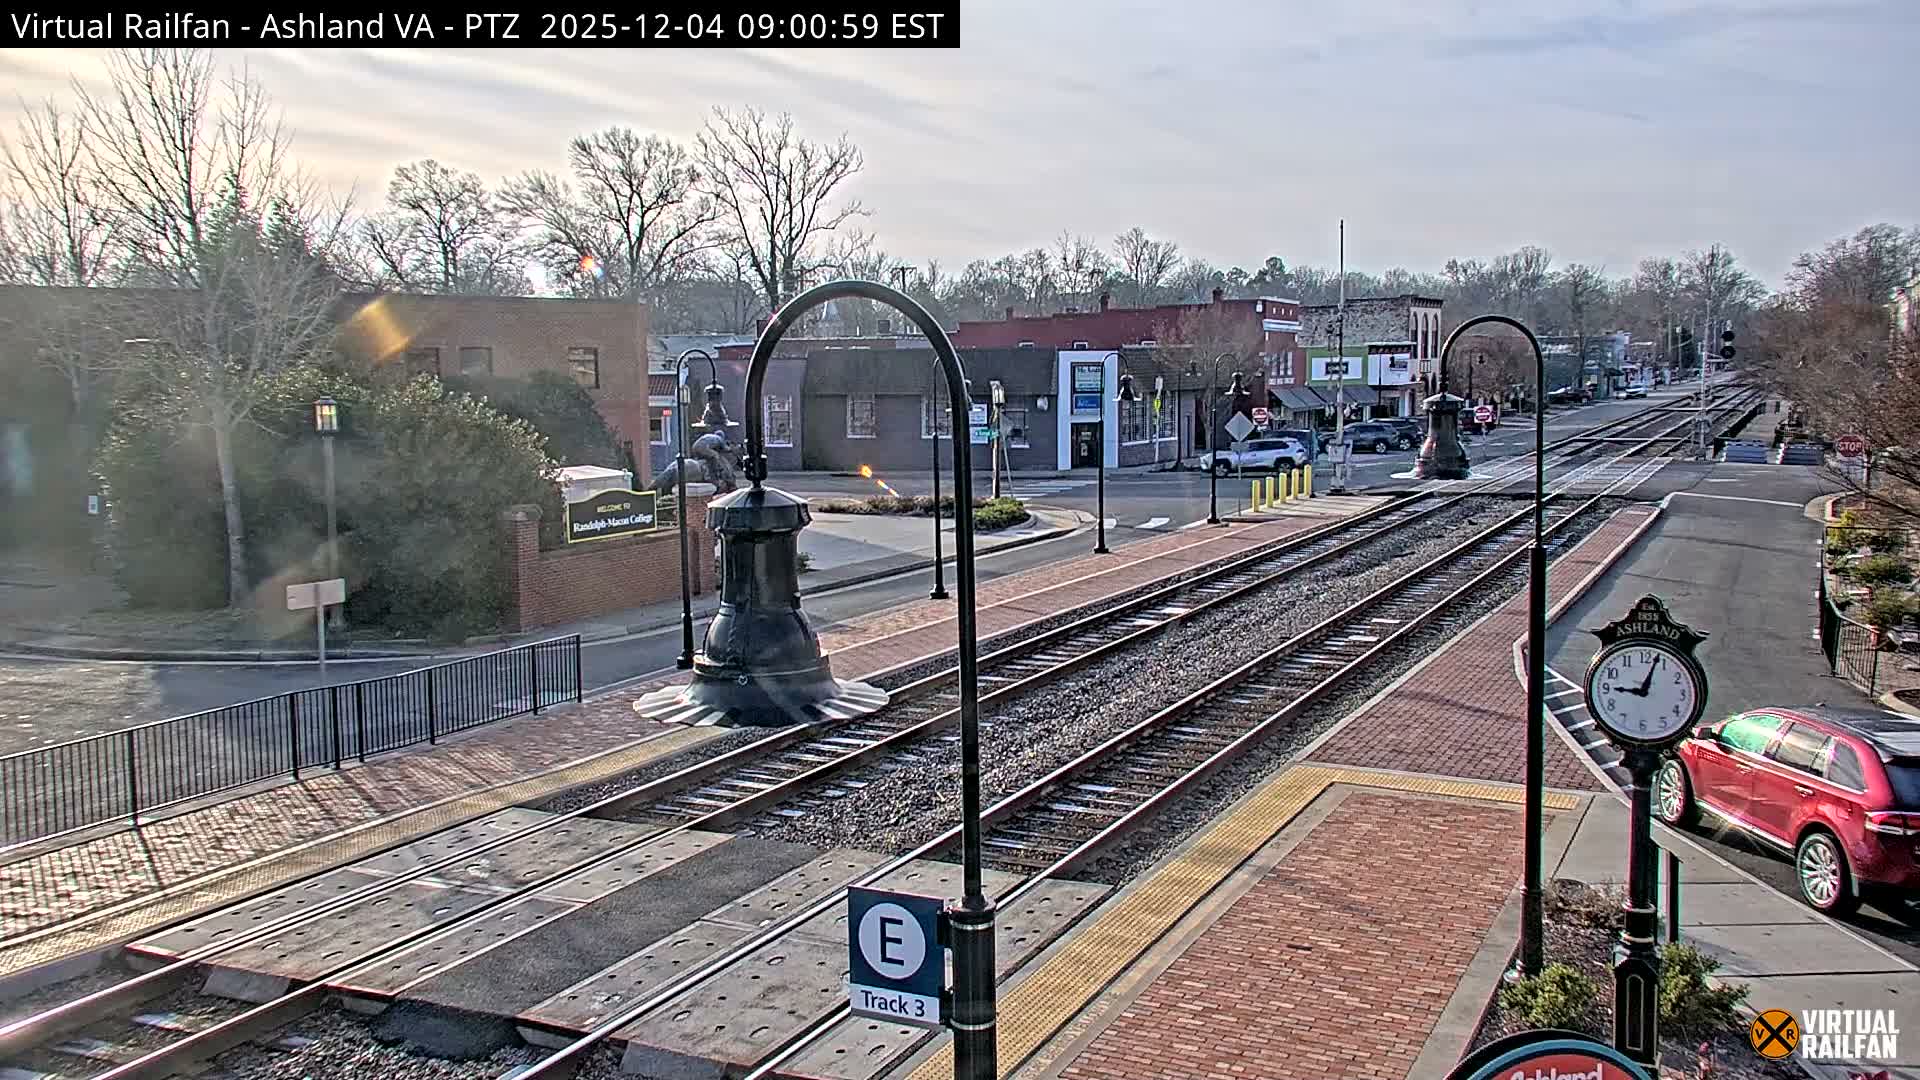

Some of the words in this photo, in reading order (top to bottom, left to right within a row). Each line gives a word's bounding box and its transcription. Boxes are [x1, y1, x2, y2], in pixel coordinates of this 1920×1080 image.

[1839, 441, 1862, 451] STOP
[573, 516, 629, 532] Randolph-Macon
[1616, 622, 1680, 639] ASHLAND
[1622, 655, 1632, 667] 11
[1640, 652, 1652, 664] 12
[1661, 659, 1666, 670] 1
[1607, 667, 1618, 679] 10
[1674, 672, 1682, 685] 2
[1602, 682, 1610, 694] 9
[1680, 690, 1686, 702] 3
[1607, 699, 1615, 711] 8
[1672, 705, 1680, 717] 4
[1619, 712, 1628, 722] 7
[1659, 716, 1668, 728] 5
[1640, 719, 1648, 731] 6
[880, 916, 905, 966] E
[861, 990, 909, 1015] Track
[914, 999, 926, 1017] 3
